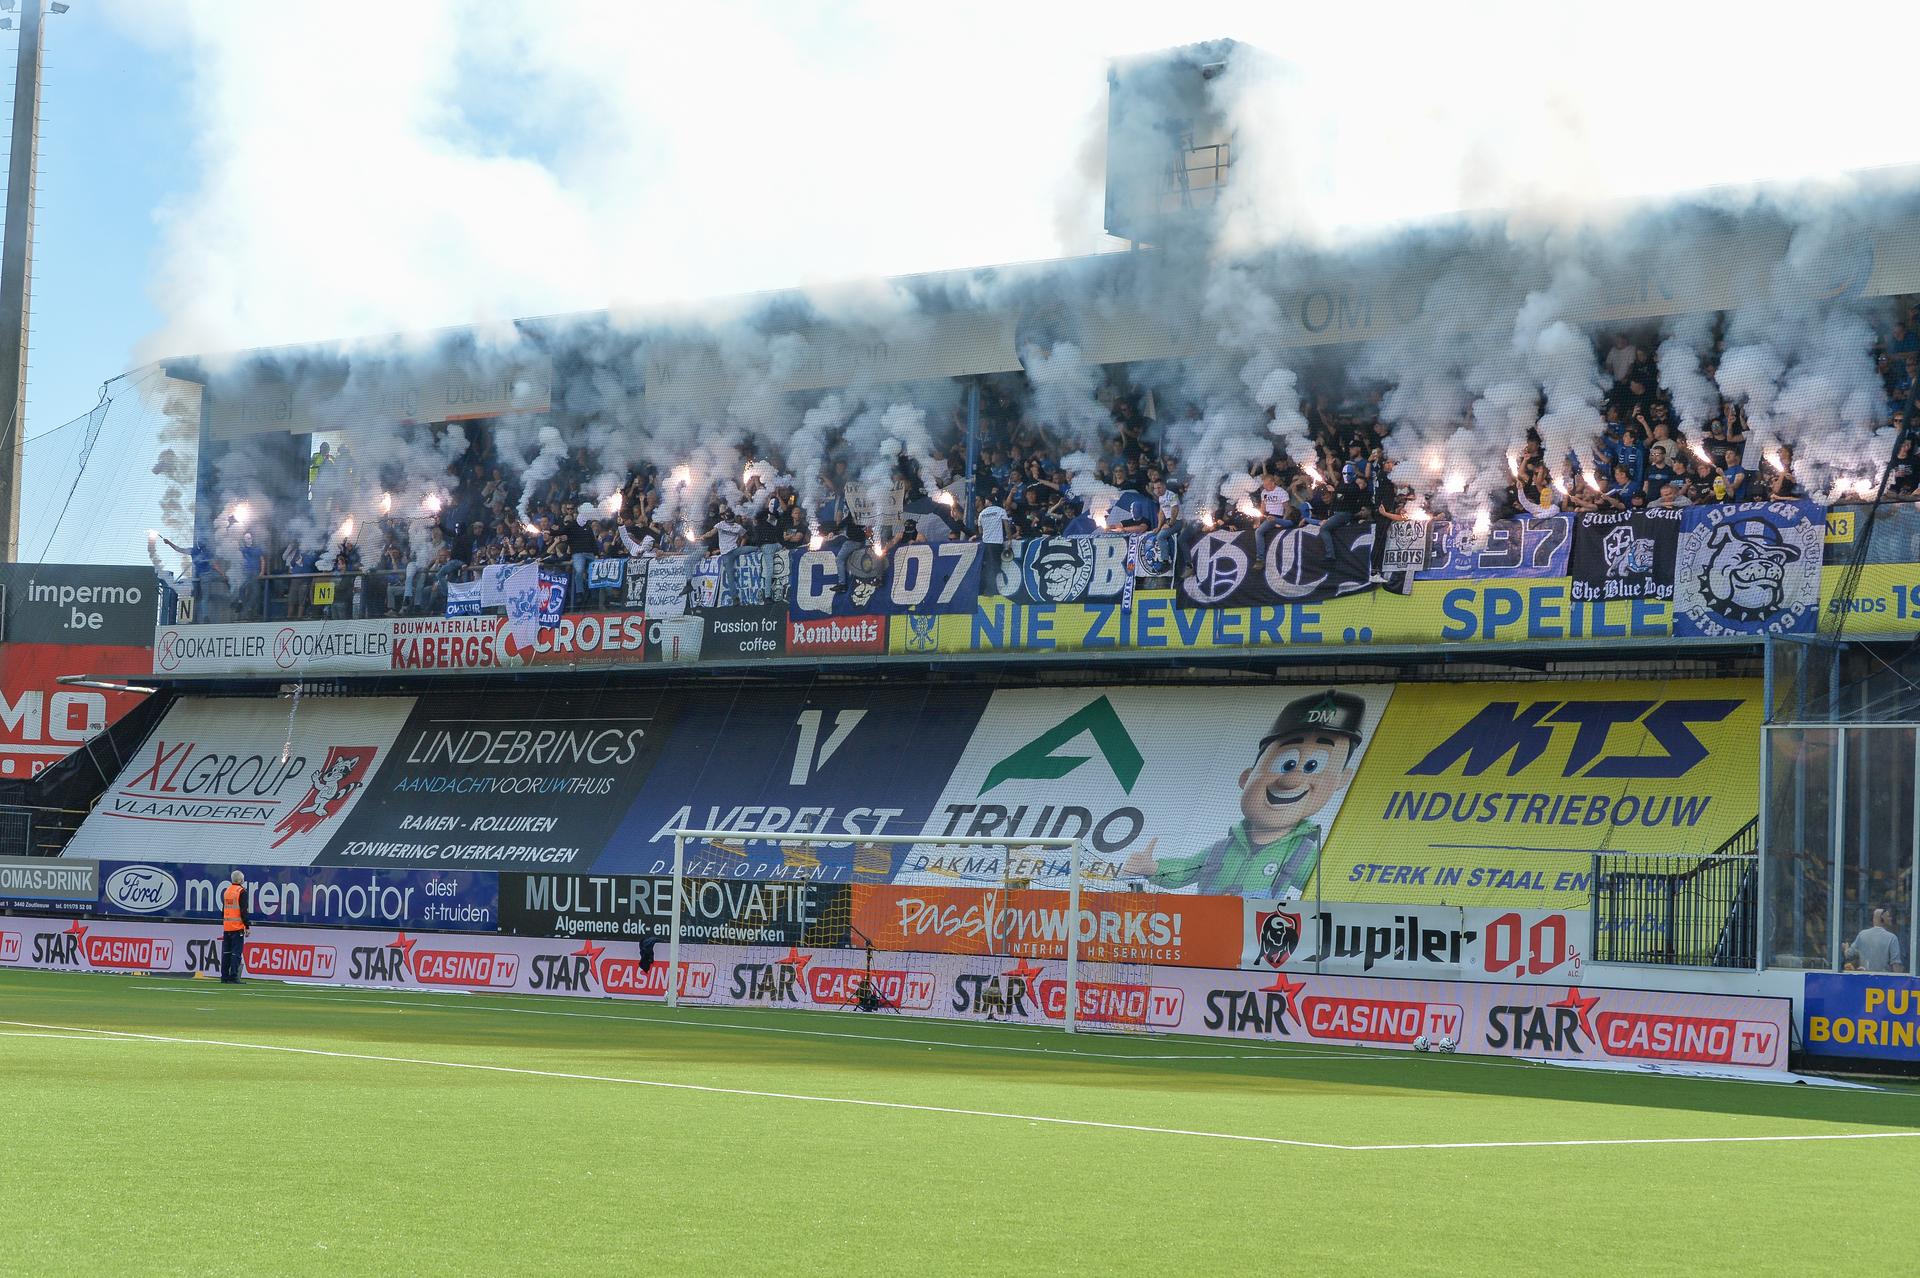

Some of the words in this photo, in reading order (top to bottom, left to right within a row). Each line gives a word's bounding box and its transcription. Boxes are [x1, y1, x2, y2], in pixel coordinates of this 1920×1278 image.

[1825, 519, 1848, 536] N3
[28, 579, 142, 607] impermo
[319, 587, 331, 599] N1
[1571, 580, 1600, 601] The
[1603, 578, 1642, 599] Blue
[63, 607, 104, 629] .be
[1441, 586, 1668, 640] SPEILE
[1829, 597, 1887, 613] SINDS
[393, 619, 496, 636] BOUWMATERIALEN
[534, 615, 643, 653] CROES
[713, 619, 759, 634] Passion
[761, 619, 778, 632] for
[792, 619, 878, 645] Rombouts
[970, 602, 1056, 649] NIE
[1083, 599, 1323, 647] ZIEVERE
[391, 634, 498, 669] KABERGS
[739, 637, 777, 652] coffee
[1308, 710, 1336, 723] DM
[406, 728, 645, 765] LINDEBRINGS
[1404, 700, 1746, 778] MTS
[393, 776, 615, 795] AANDACHTVOORUWTHUIS
[114, 798, 276, 820] VLAANDEREN
[399, 815, 460, 831] RAMEN
[469, 816, 558, 833] ROLLUIKEN
[1382, 791, 1713, 827] INDUSTRIEBOUW
[935, 804, 1145, 853] TRUDO
[340, 841, 437, 860] ZONWERING
[440, 844, 579, 863] OVERKAPPINGEN
[913, 855, 1124, 878] DAKMATERIAEN
[119, 872, 164, 903] Ford
[425, 878, 458, 897] diest
[1348, 863, 1431, 886] STERK
[1434, 866, 1464, 887] IN
[1467, 867, 1547, 890] STAAL
[1553, 872, 1592, 892] EN
[312, 875, 415, 921] motor
[424, 903, 489, 922] st-truiden
[525, 875, 817, 924] MULTI-RENOVATIE
[555, 915, 619, 935] Algemene
[622, 918, 651, 935] dak-
[654, 923, 670, 936] en
[679, 922, 785, 942] enovatiewerken
[1302, 911, 1477, 972] Jupiler
[5, 939, 19, 954] TV
[32, 932, 80, 966] STAR
[91, 940, 149, 964] CASINO
[155, 946, 169, 961] TV
[184, 939, 220, 972] STA
[248, 947, 312, 971] CASINO
[318, 954, 332, 970] TV
[1008, 943, 1064, 956] INTERIM
[1088, 946, 1105, 957] HR
[1113, 947, 1182, 961] SERVICES
[1484, 912, 1566, 979] 0,0
[350, 946, 405, 982] STAR
[419, 955, 490, 981] CASINO
[497, 962, 514, 979] TV
[528, 954, 591, 992] STAR
[692, 971, 711, 990] TV
[729, 963, 799, 1002] STAR
[815, 973, 900, 1002] CASNO
[908, 981, 930, 1000] TV
[952, 974, 1028, 1017] STAR
[1048, 986, 1145, 1018] CSINO
[1154, 996, 1178, 1016] TV
[1203, 988, 1291, 1036] STAR
[1312, 1003, 1421, 1037] CASINO
[1430, 1013, 1457, 1035] TV
[1486, 1005, 1583, 1054] STAR
[1608, 1018, 1731, 1056] CASINO
[1742, 1032, 1772, 1055] TV
[1809, 1016, 1920, 1048] BORIN
